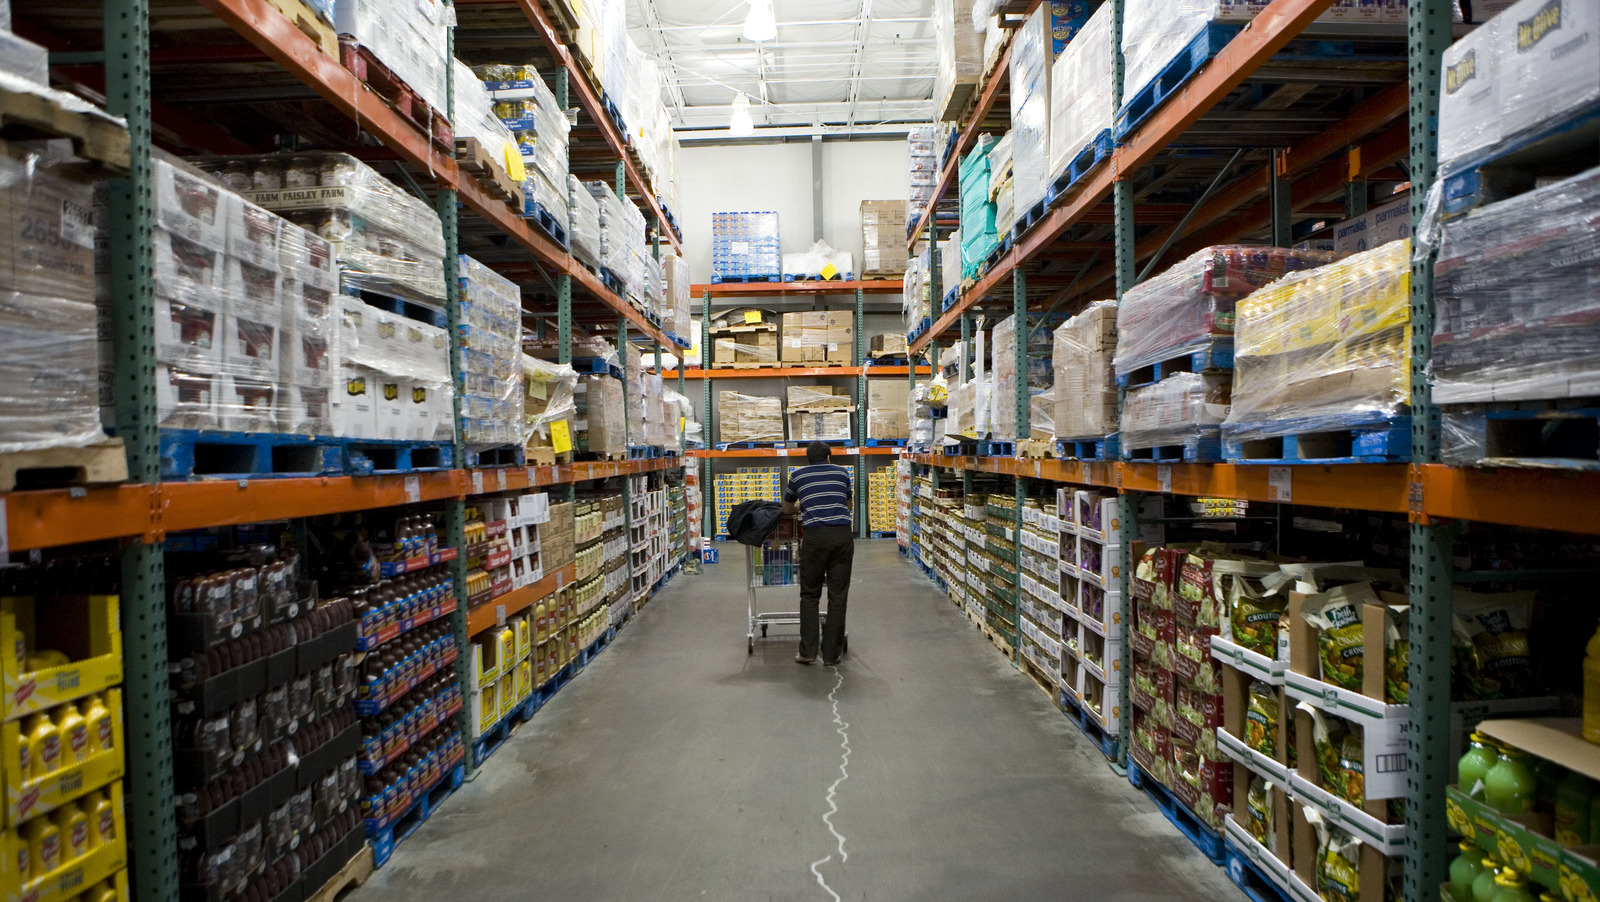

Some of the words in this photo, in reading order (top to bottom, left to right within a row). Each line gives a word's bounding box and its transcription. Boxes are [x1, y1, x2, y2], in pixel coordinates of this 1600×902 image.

[256, 193, 279, 202] FARM
[283, 191, 318, 201] PAISLEY
[321, 188, 345, 198] FARM
[1375, 201, 1410, 228] parmalat
[1338, 218, 1367, 240] parmalat
[1336, 633, 1364, 648] ORGAN
[1343, 649, 1364, 658] CROU
